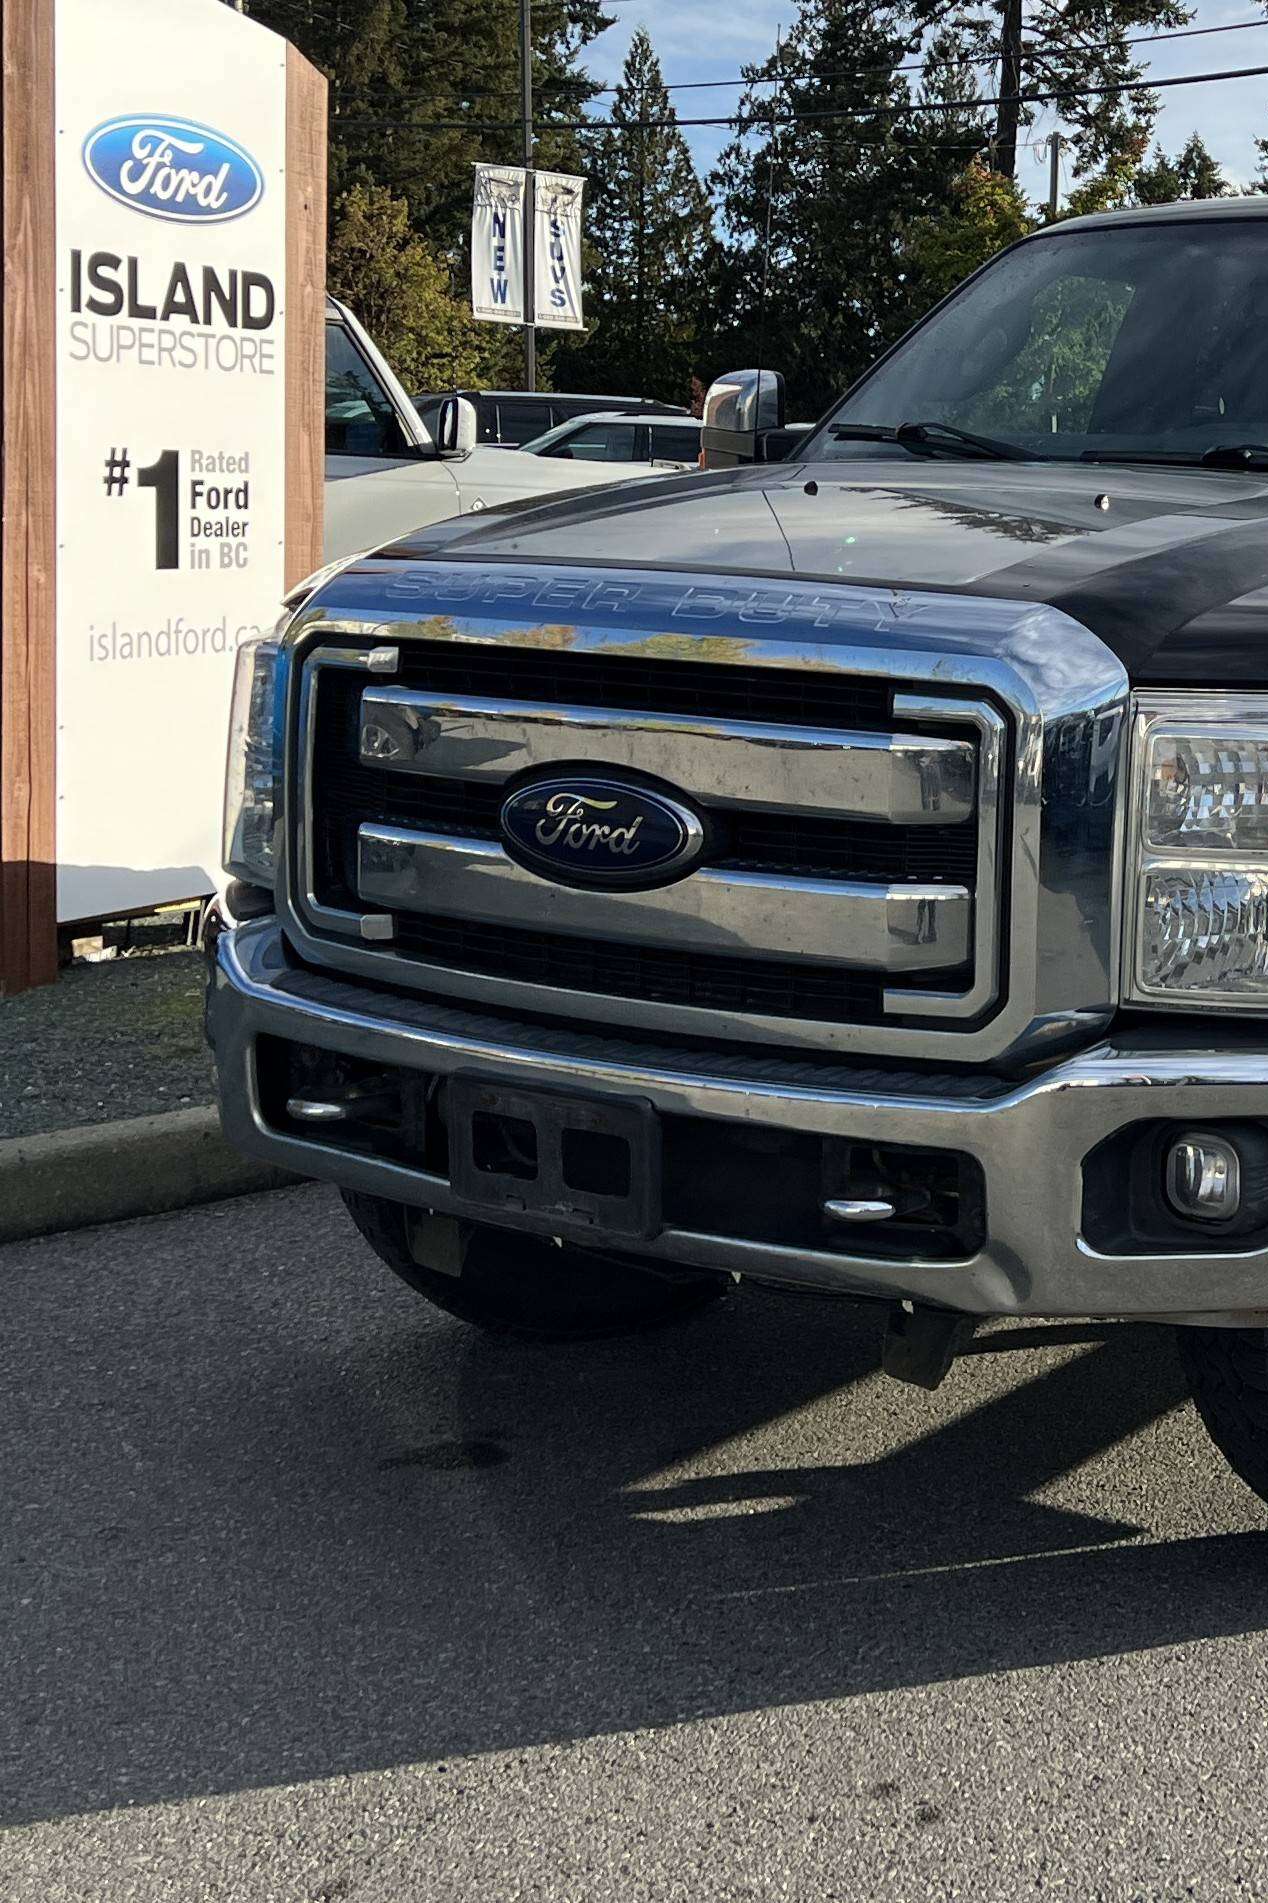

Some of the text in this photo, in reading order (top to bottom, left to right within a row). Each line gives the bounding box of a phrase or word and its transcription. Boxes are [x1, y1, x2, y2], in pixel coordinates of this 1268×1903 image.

[119, 129, 229, 208] Ford
[490, 212, 508, 304] NEW
[70, 249, 275, 330] ISLAND
[69, 320, 275, 375] SUPERSTORE
[190, 449, 250, 474] Rated
[103, 447, 180, 570] #1
[190, 479, 249, 510] Ford
[190, 516, 249, 538] Dealer
[190, 541, 249, 570] in BC
[385, 570, 930, 632] SUPER DUTY
[535, 793, 644, 855] Ford
